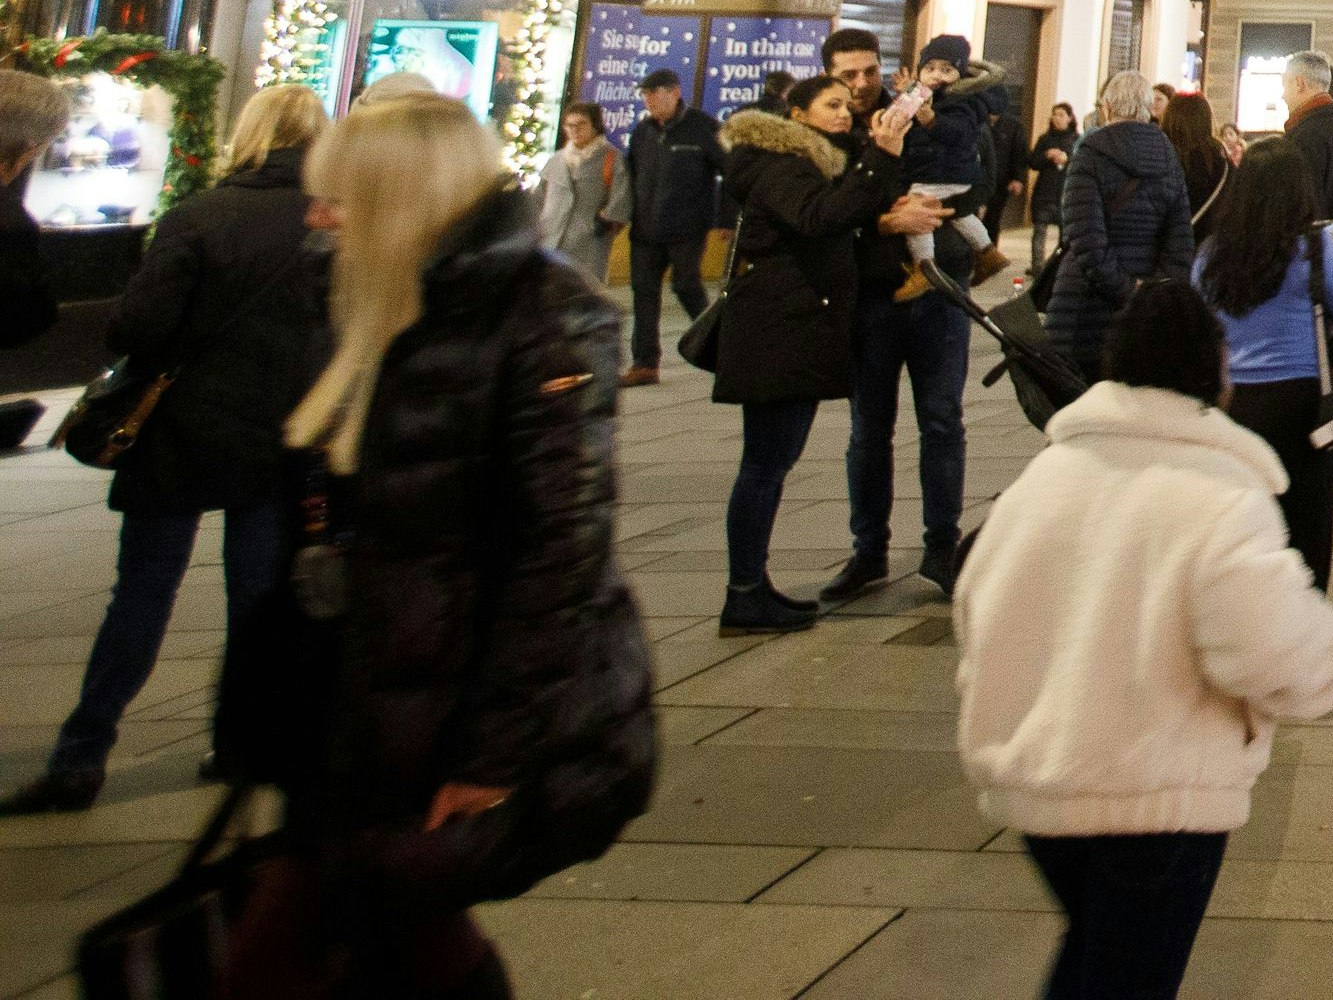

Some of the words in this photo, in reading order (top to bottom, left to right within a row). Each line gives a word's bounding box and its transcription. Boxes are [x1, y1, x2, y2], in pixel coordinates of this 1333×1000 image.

[602, 28, 623, 48] Sie
[639, 36, 672, 55] for
[725, 37, 747, 56] In
[751, 37, 792, 56] that
